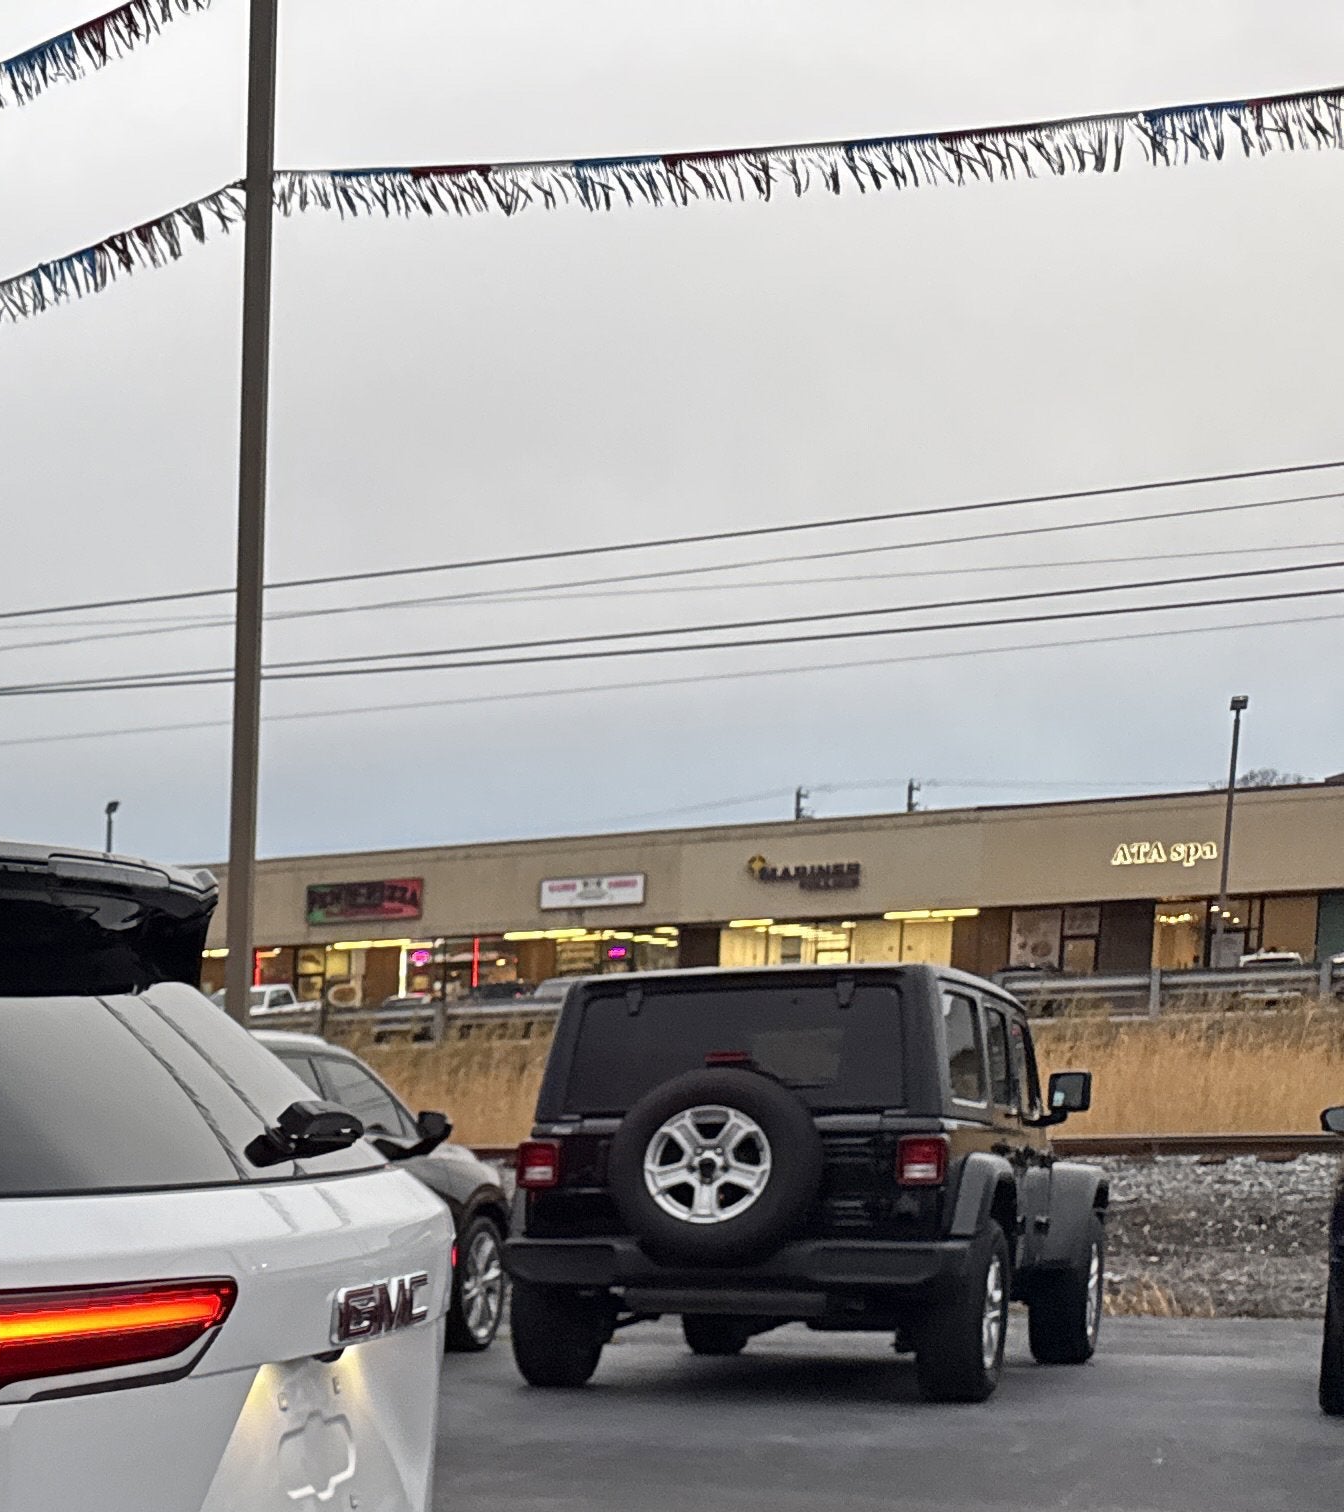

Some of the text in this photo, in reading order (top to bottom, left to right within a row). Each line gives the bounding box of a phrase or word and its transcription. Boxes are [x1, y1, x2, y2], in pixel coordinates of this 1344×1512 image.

[1110, 841, 1218, 867] ATA spa
[331, 1270, 430, 1345] GMC
